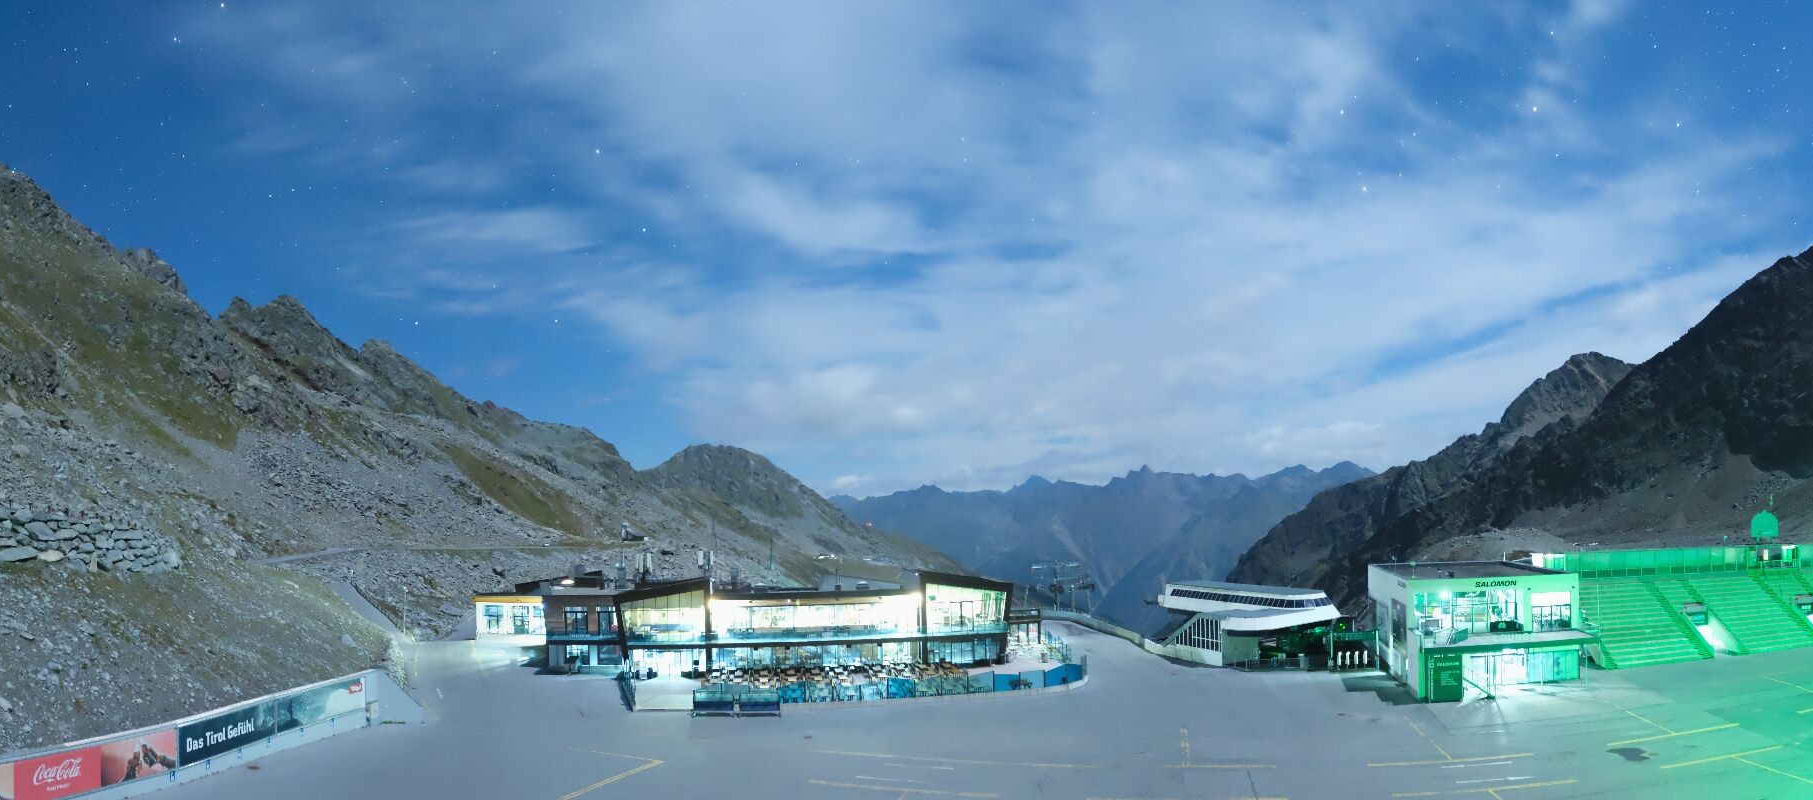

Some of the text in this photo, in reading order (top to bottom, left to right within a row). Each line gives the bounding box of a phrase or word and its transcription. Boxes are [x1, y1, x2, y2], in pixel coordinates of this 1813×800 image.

[187, 718, 255, 752] Das Tirol Gefühl
